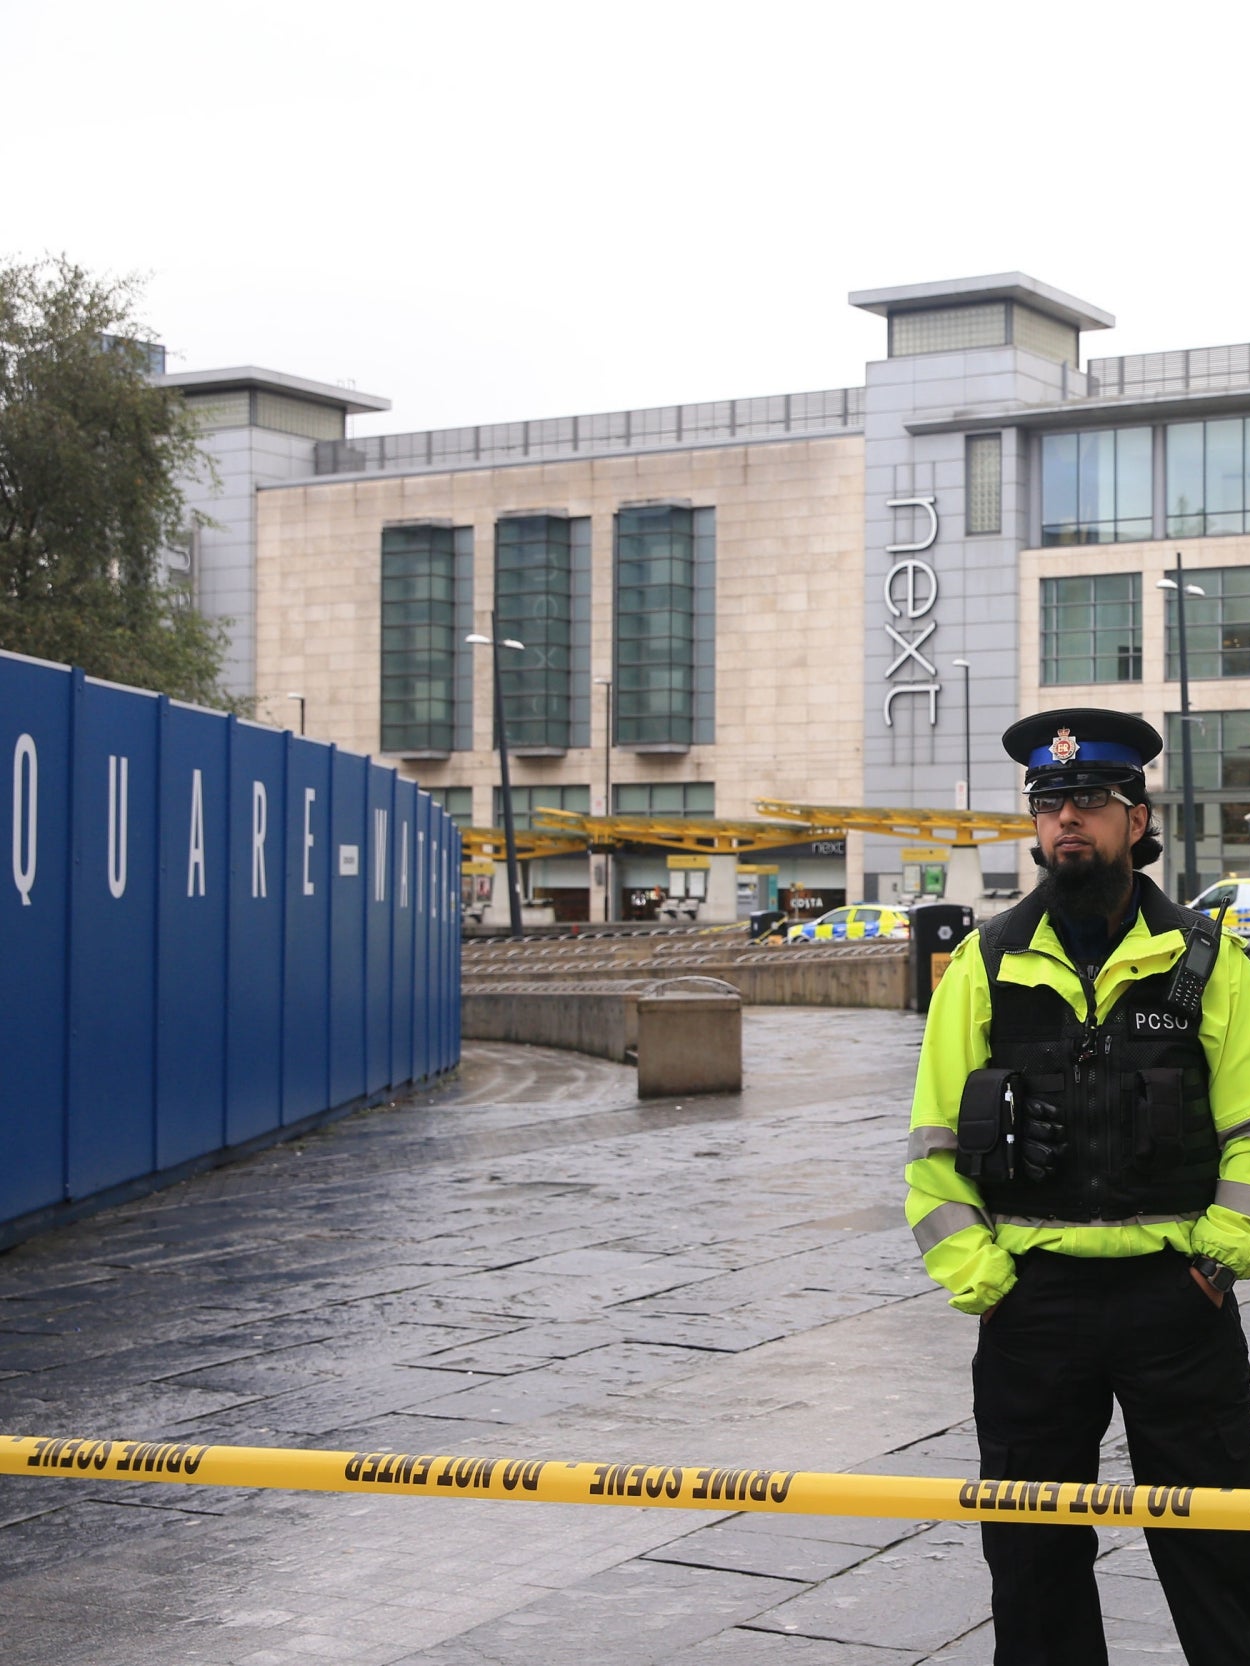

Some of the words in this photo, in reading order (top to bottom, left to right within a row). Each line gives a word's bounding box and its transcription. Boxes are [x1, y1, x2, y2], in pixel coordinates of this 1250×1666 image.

[885, 496, 941, 727] next
[12, 732, 315, 906] QUARE
[790, 897, 823, 909] COSTA
[27, 1438, 112, 1470] SCENE
[116, 1442, 211, 1475] CRIME
[345, 1452, 436, 1484] ENTER
[437, 1457, 498, 1488] NOT
[502, 1459, 546, 1491] DO
[589, 1463, 683, 1499] SCENE
[692, 1468, 795, 1503] CRIME
[959, 1479, 1061, 1511] ENTER
[1069, 1483, 1135, 1515] NOT
[1147, 1486, 1193, 1517] DO
